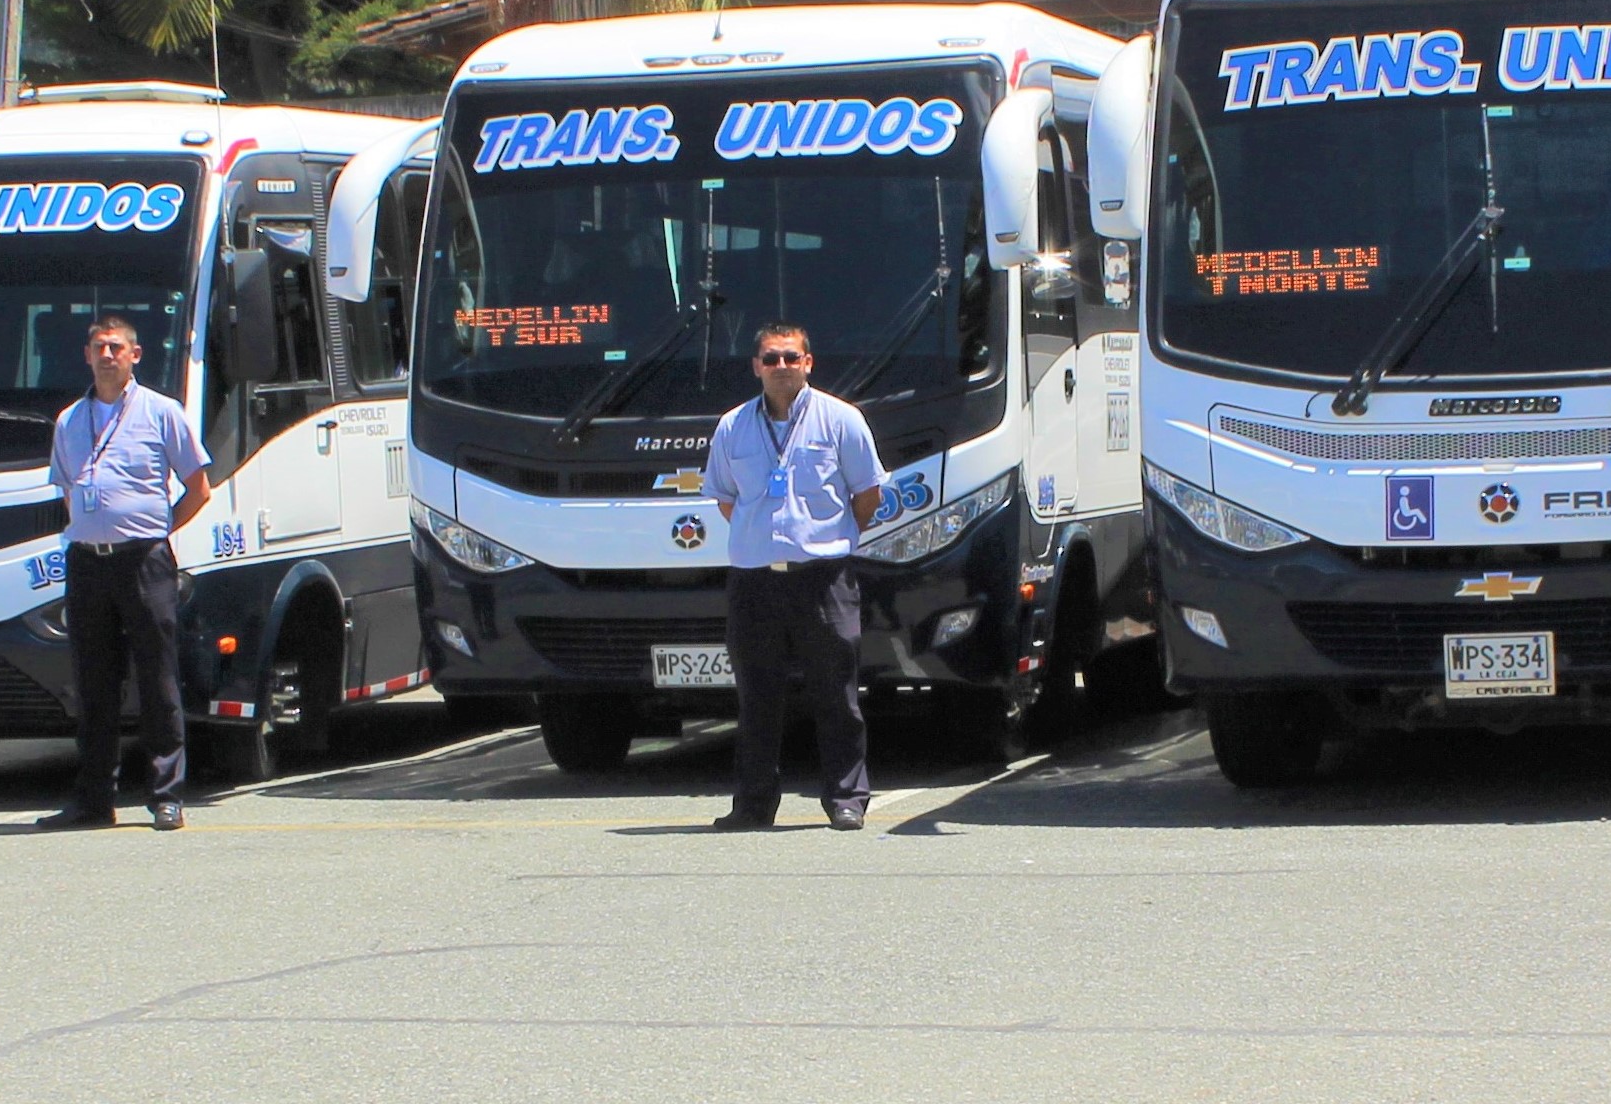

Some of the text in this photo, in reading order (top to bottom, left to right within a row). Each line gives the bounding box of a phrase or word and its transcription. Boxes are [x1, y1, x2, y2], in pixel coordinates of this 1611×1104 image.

[1218, 29, 1482, 111] TRANS.
[473, 97, 963, 173] TRANS. UNIDOS
[1196, 246, 1378, 274] MEDELLIN
[1206, 270, 1370, 295] T NORTE
[455, 304, 608, 327] MEDELLIN
[487, 326, 582, 346] T SUR
[339, 407, 386, 422] CHEVROLET
[635, 436, 713, 451] Marcop
[861, 471, 934, 531] 95
[213, 524, 245, 557] 184
[694, 676, 713, 684] CEJA
[1496, 670, 1517, 678] CEJA
[1476, 685, 1553, 695] CHEVROLET
